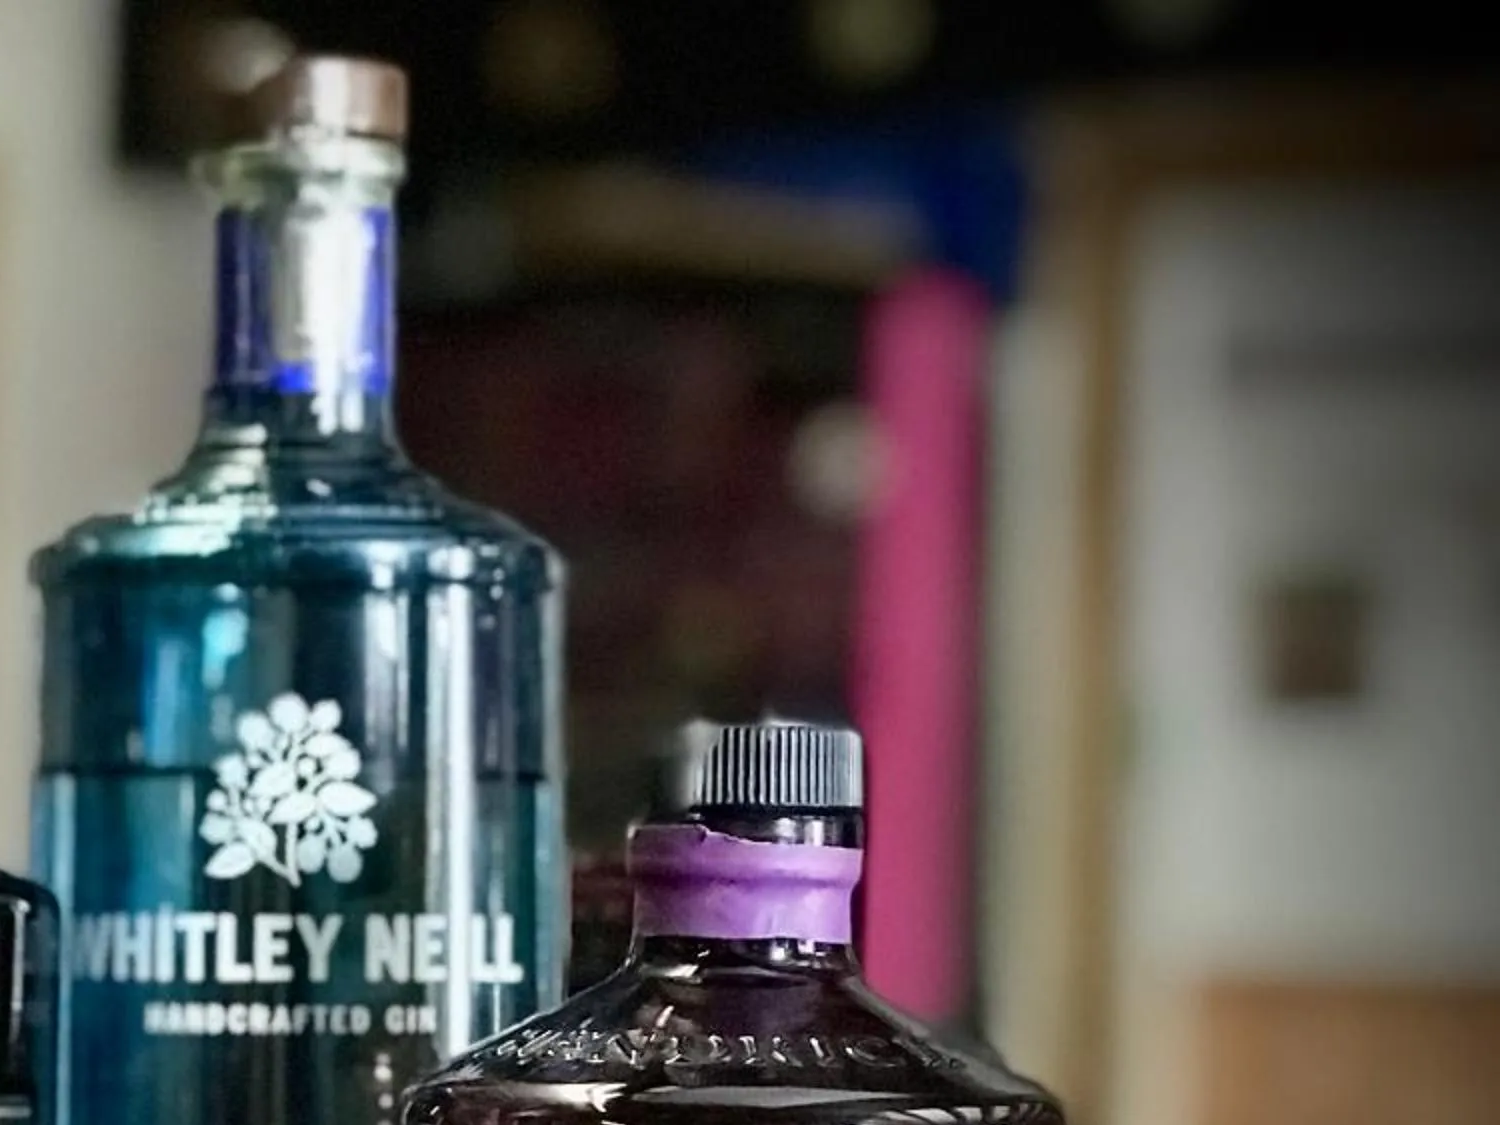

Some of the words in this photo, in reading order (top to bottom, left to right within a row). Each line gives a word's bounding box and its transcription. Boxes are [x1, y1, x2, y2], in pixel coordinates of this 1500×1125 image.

[66, 903, 345, 985] WHITLEY
[365, 912, 525, 985] NELL
[143, 1004, 370, 1036] HANDCRAFTED
[384, 1006, 437, 1035] GIN
